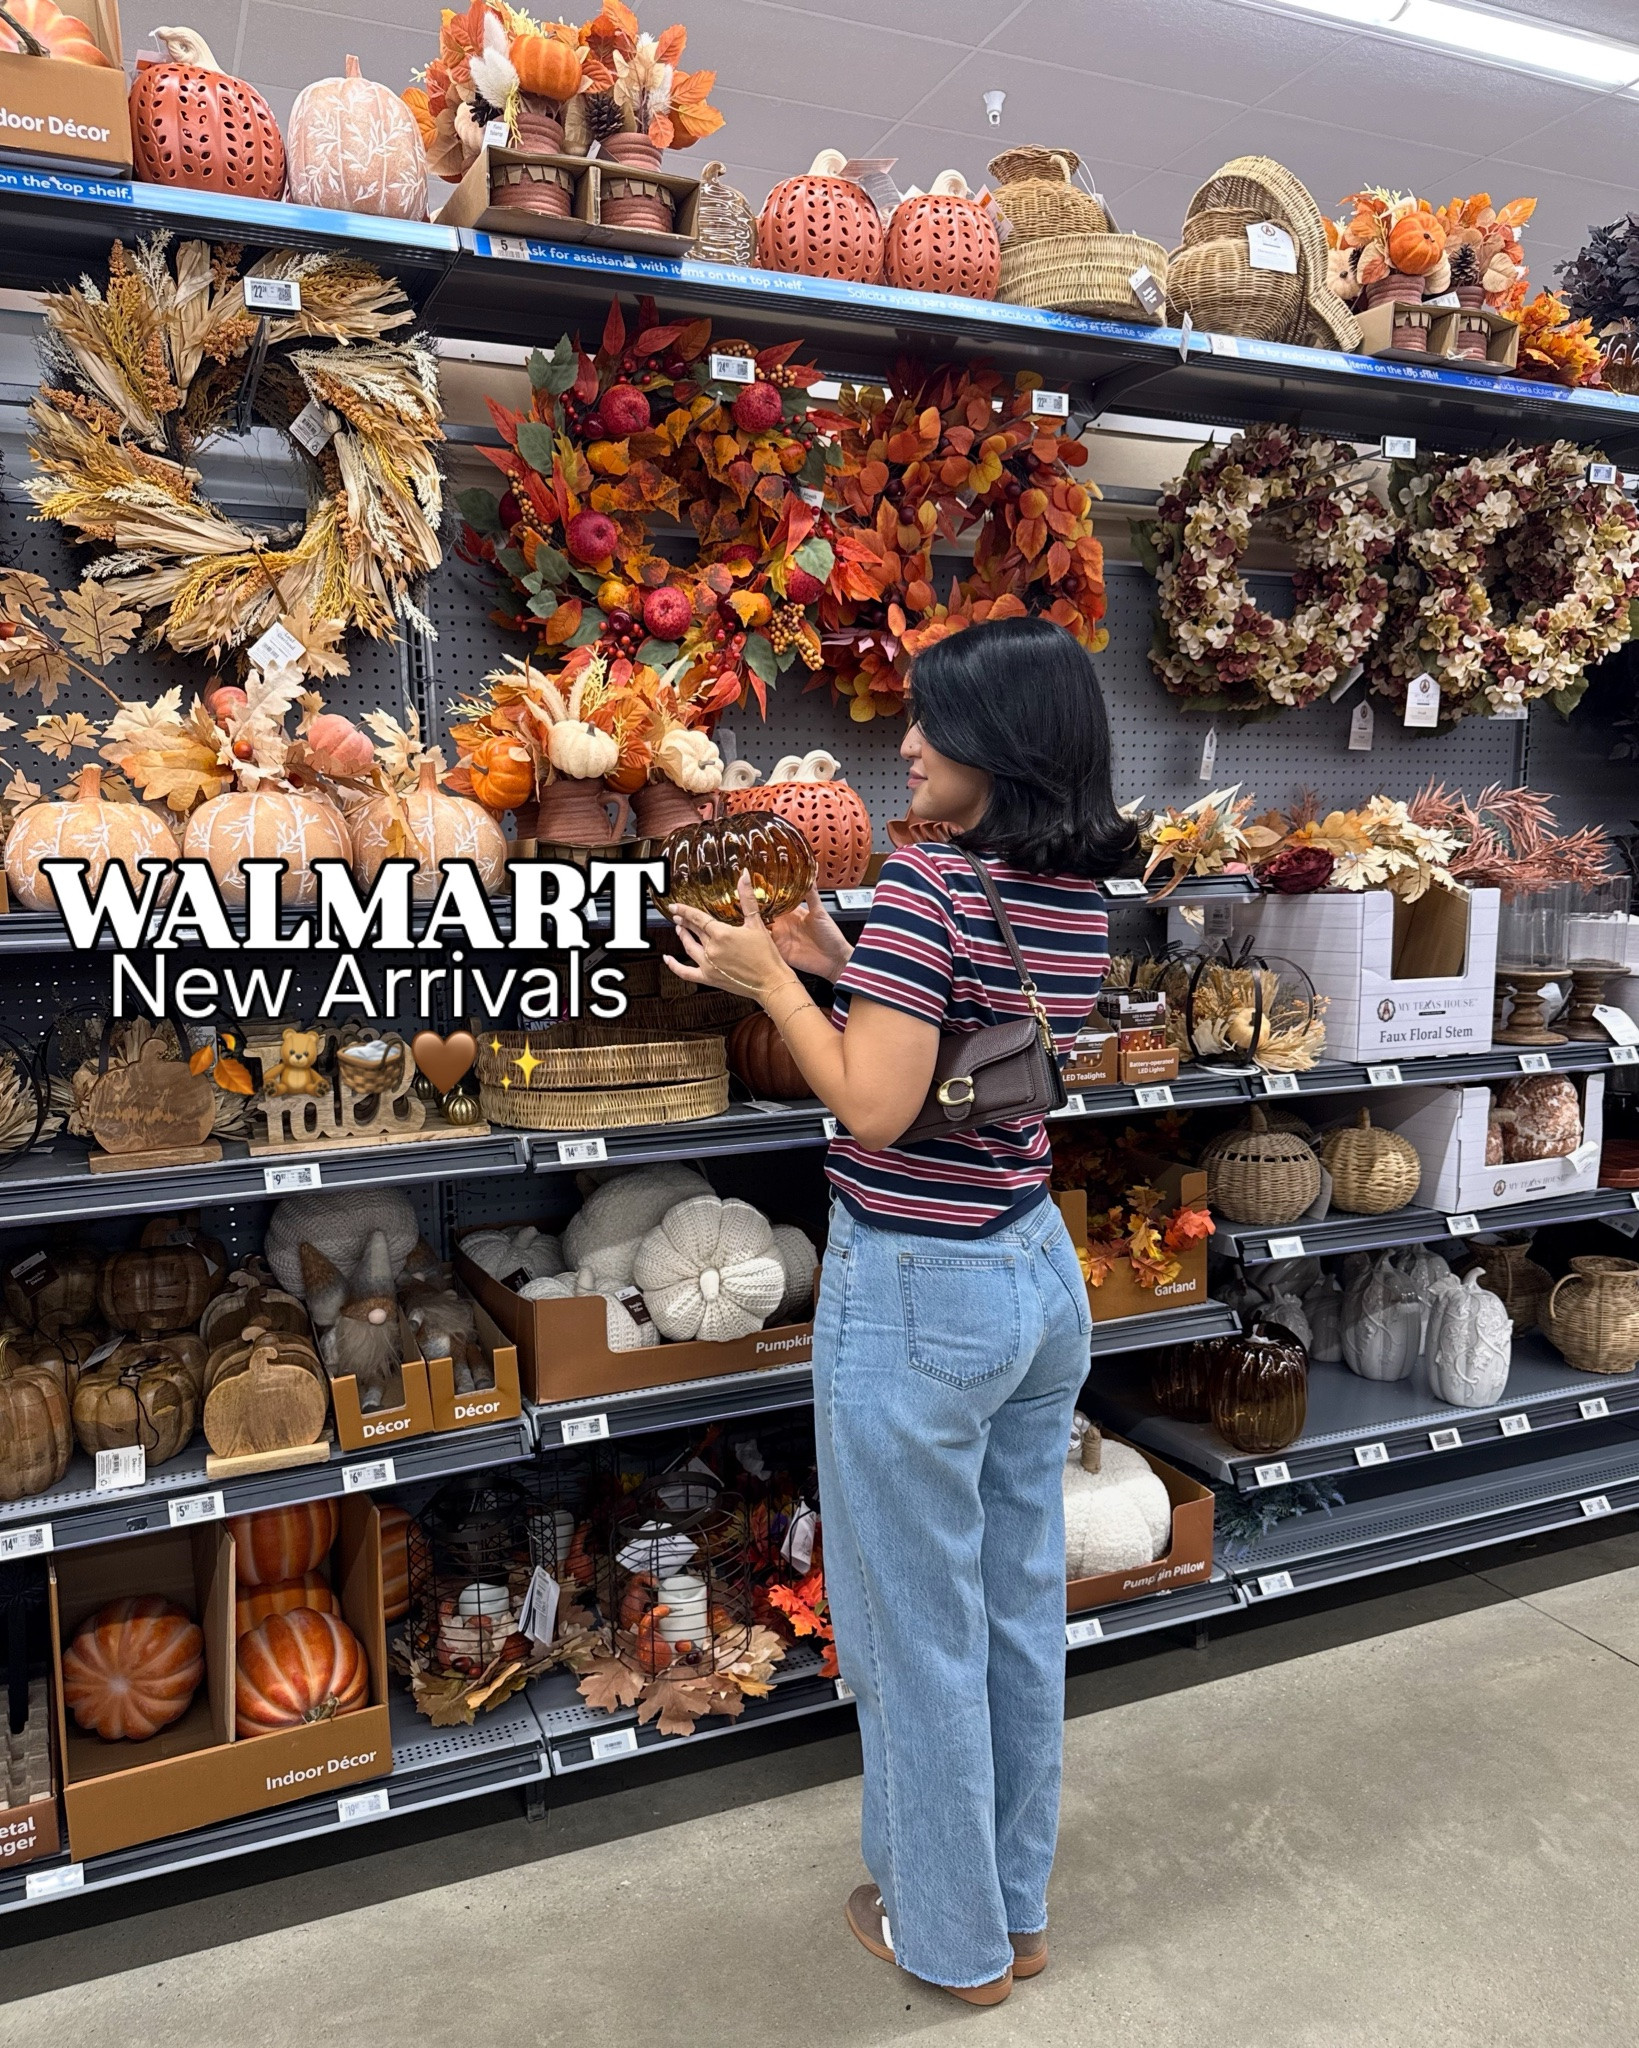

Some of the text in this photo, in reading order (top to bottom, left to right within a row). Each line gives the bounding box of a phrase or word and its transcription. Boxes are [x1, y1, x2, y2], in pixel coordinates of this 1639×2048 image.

[48, 115, 111, 142] Décor
[22, 174, 51, 189] the
[56, 180, 84, 196] top
[88, 183, 132, 200] shelf.
[551, 248, 569, 260] for
[641, 261, 668, 274] with
[671, 265, 706, 279] items
[710, 270, 725, 280] on
[727, 272, 748, 284] the
[751, 275, 771, 289] top
[773, 278, 805, 292] shelf.
[847, 287, 886, 303] Solicita
[889, 296, 921, 308] ayuda
[922, 297, 947, 310] para
[949, 300, 988, 315] obtener
[1101, 323, 1136, 337] estante
[1249, 345, 1269, 357] Ask
[1269, 347, 1281, 358] for
[1283, 351, 1327, 366] assistance
[1328, 354, 1348, 368] with
[1374, 364, 1386, 373] on
[1387, 363, 1402, 376] the
[1398, 999, 1475, 1012] MY TEXAS HOUSE
[1379, 1025, 1473, 1044] Faux Floral Stem
[1129, 1058, 1175, 1069] Battery-operated
[1138, 1065, 1166, 1075] LED Lights
[1062, 1071, 1107, 1082] LED Tealights
[1154, 1277, 1196, 1297] Garland
[454, 1401, 501, 1420] Décor
[362, 1418, 412, 1439] Décor
[1122, 1560, 1206, 1591] Pumpin Pillow
[265, 1750, 378, 1791] Indoor Décor
